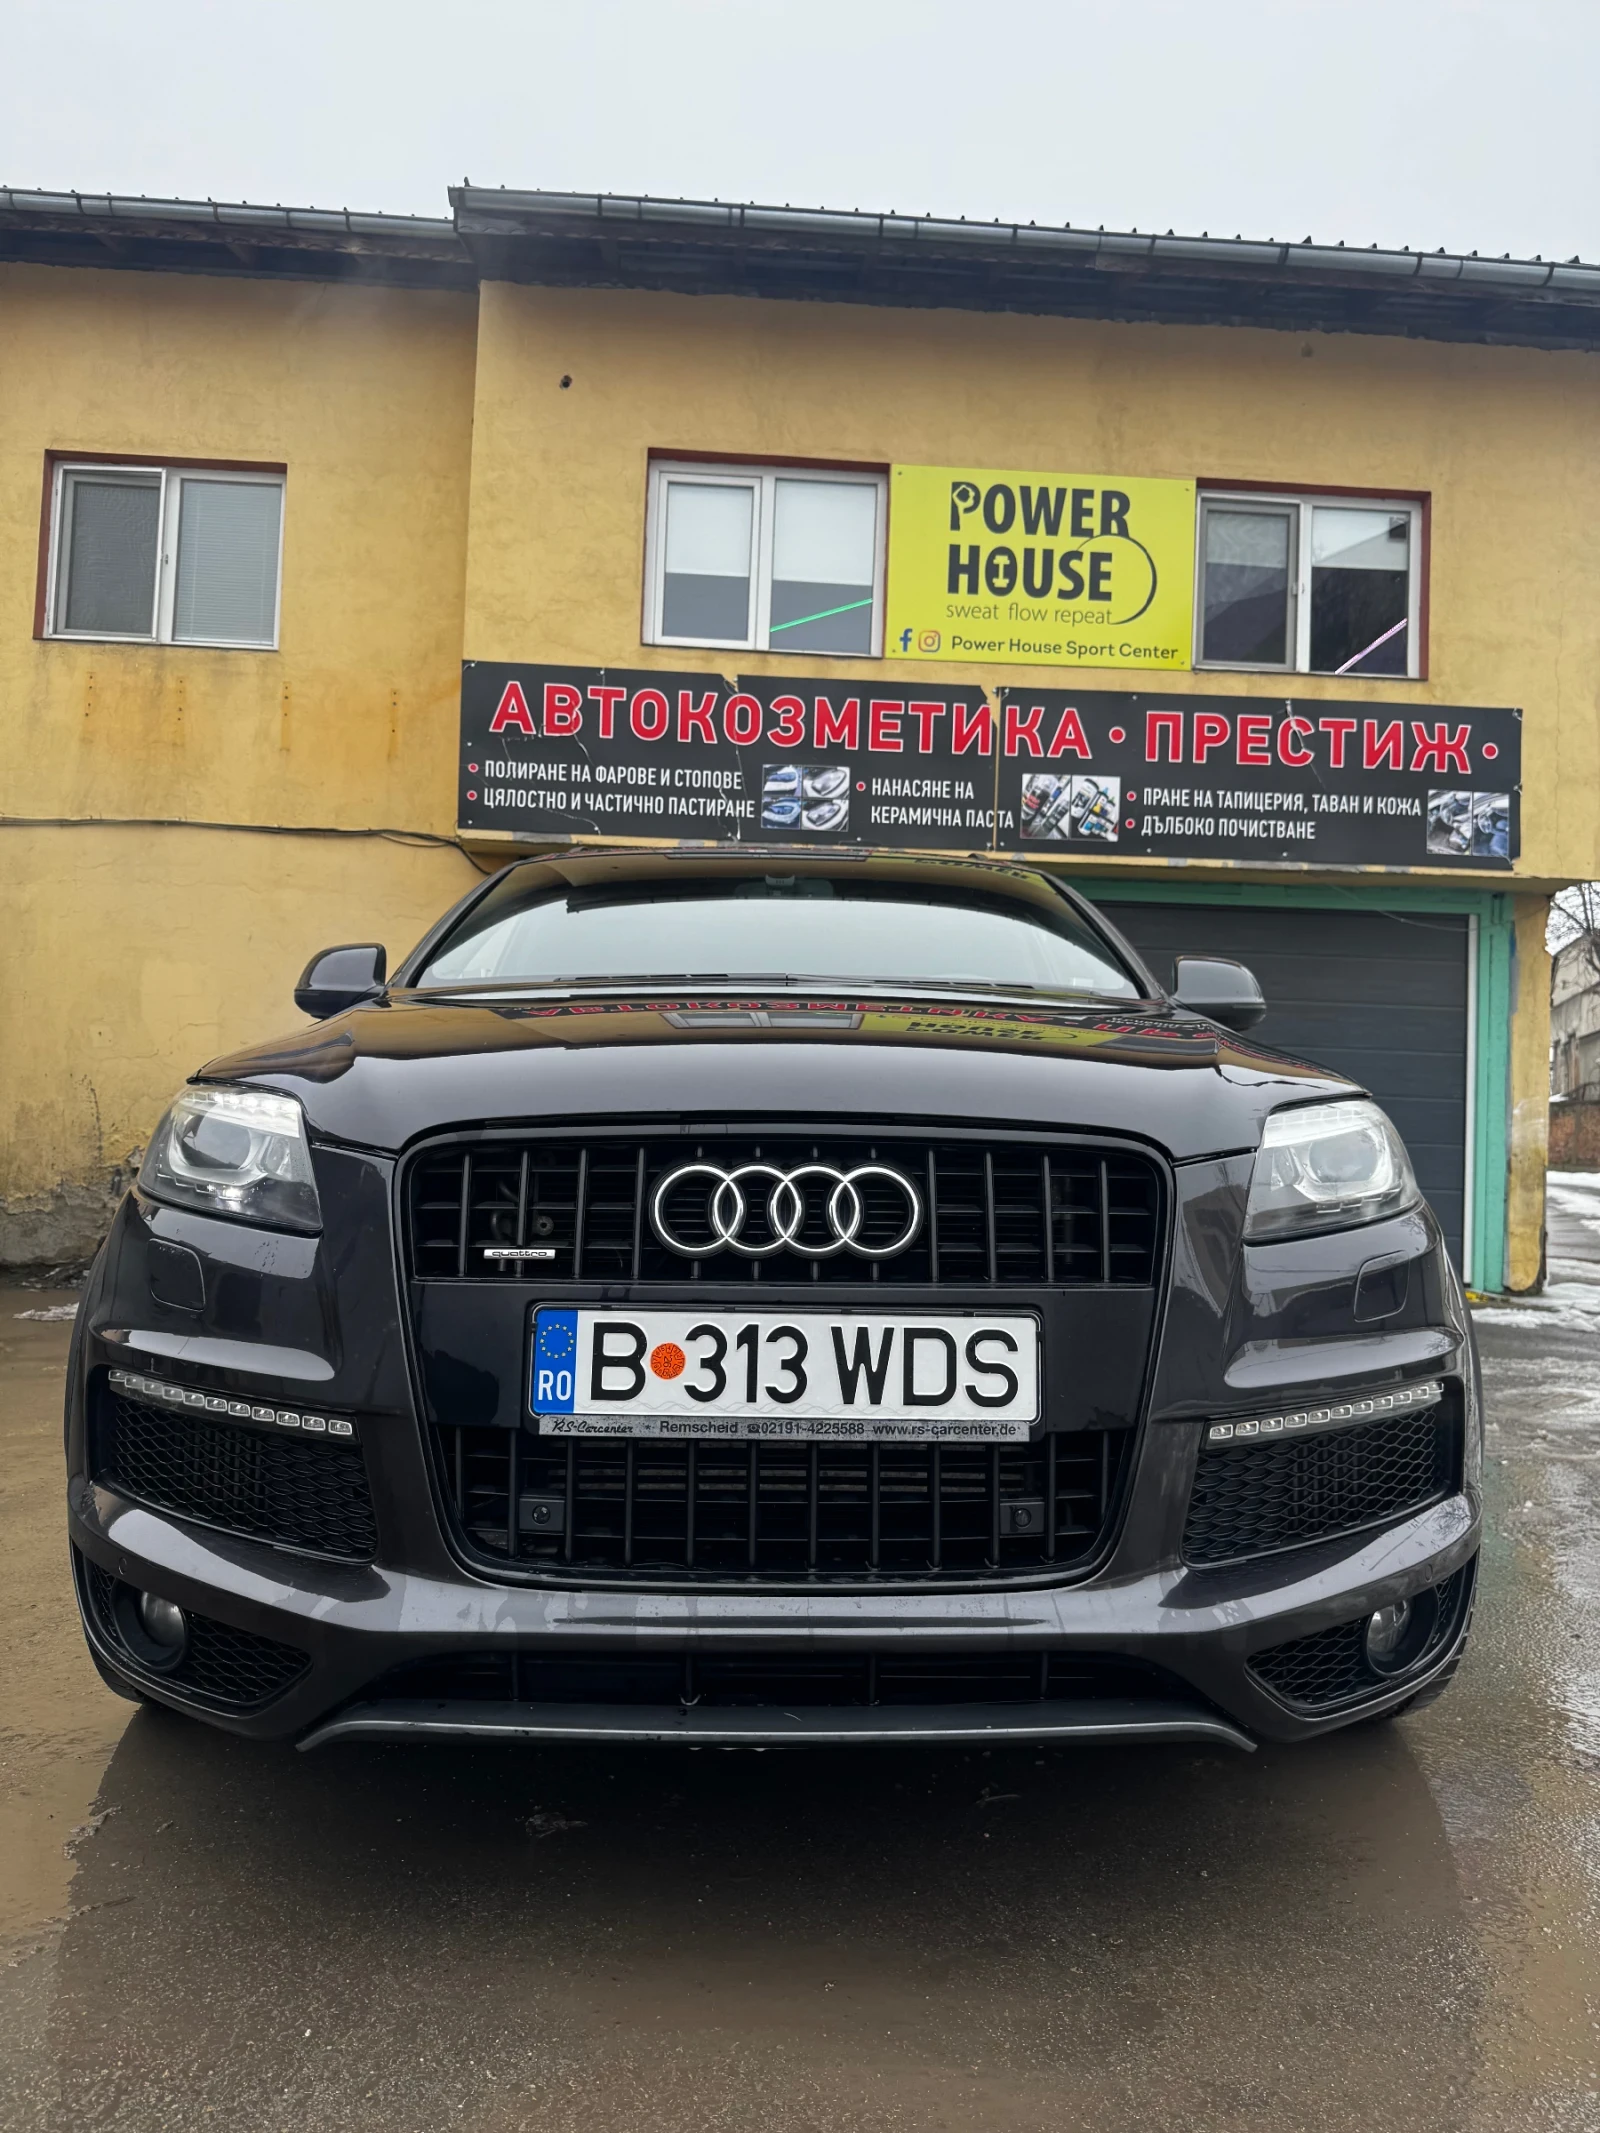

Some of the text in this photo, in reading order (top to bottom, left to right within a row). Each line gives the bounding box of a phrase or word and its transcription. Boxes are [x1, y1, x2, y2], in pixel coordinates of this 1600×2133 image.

[950, 482, 1130, 538] POWER
[947, 544, 1112, 601] HOUSE
[946, 602, 1112, 627] sweat flow repeat
[952, 636, 1179, 660] Power House Sport Center
[489, 680, 1472, 774] АВТОКОЗМЕТИКА ПРЕСТИЖ
[484, 760, 742, 790] ПОЛИРАНЕ НА ФАРОВЕ И СТОПОВЕ
[872, 778, 974, 799] НАНАСЯНЕ НА
[484, 788, 755, 818] ЦЯЛОСТНО И ЧАСТИЧНО ПАСТИРАНЕ
[1143, 787, 1422, 816] ПРАНЕ НА ТАПИЦЕРИЯ, ТАВАН И КОЖА
[871, 805, 962, 827] КЕРАМИЧНА
[966, 809, 1014, 829] ПАСТА
[1141, 816, 1316, 840] ДЪЛБОКО ПОЧИСТВАНЕ
[492, 1250, 548, 1258] quattro
[590, 1321, 1020, 1408] B 313 WDS
[538, 1370, 572, 1401] RO
[551, 1419, 1017, 1437] RS-Carcenter Remscheid 02191-4225588 www.rs-carcenter.de
